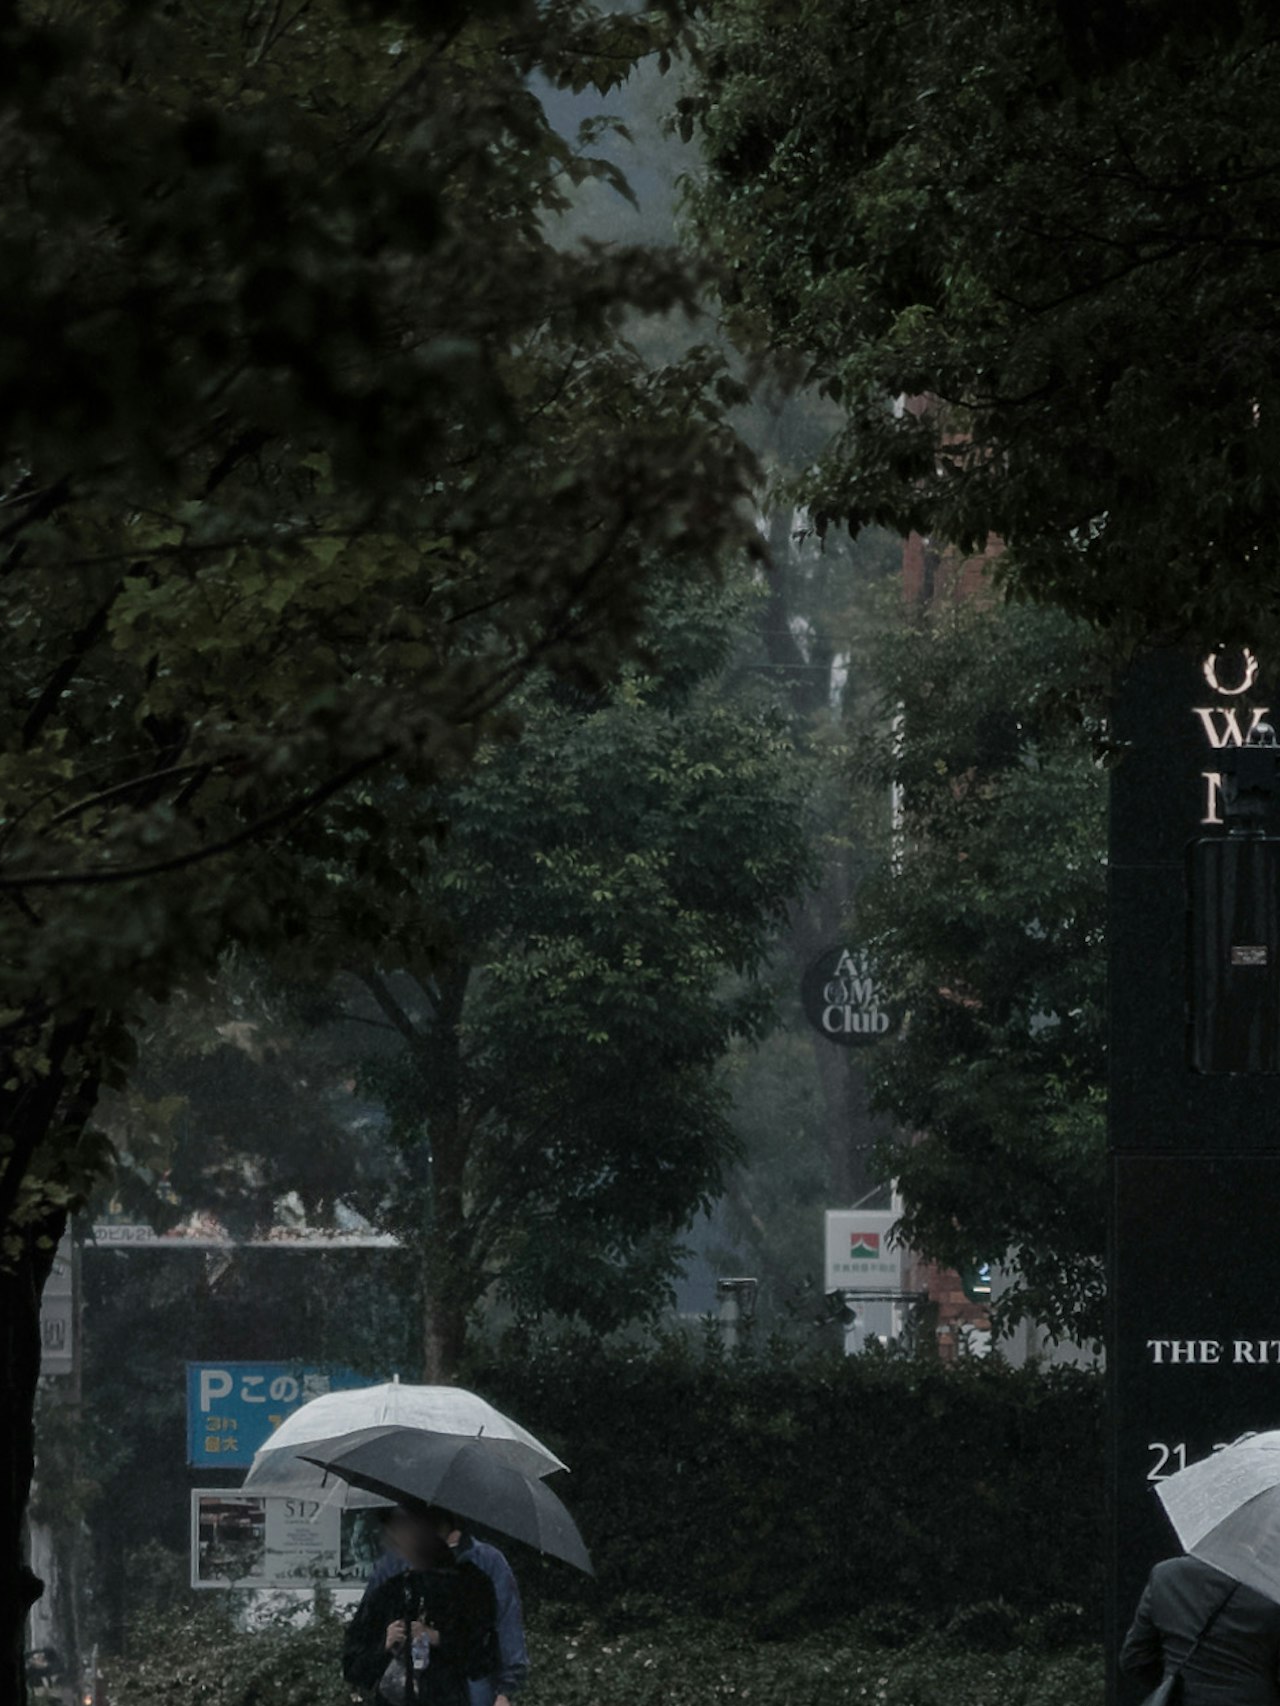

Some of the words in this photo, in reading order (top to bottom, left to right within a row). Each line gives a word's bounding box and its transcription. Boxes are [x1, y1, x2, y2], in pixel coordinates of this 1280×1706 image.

[822, 1003, 890, 1033] Club
[1147, 1339, 1222, 1365] THE
[200, 1369, 234, 1413] P
